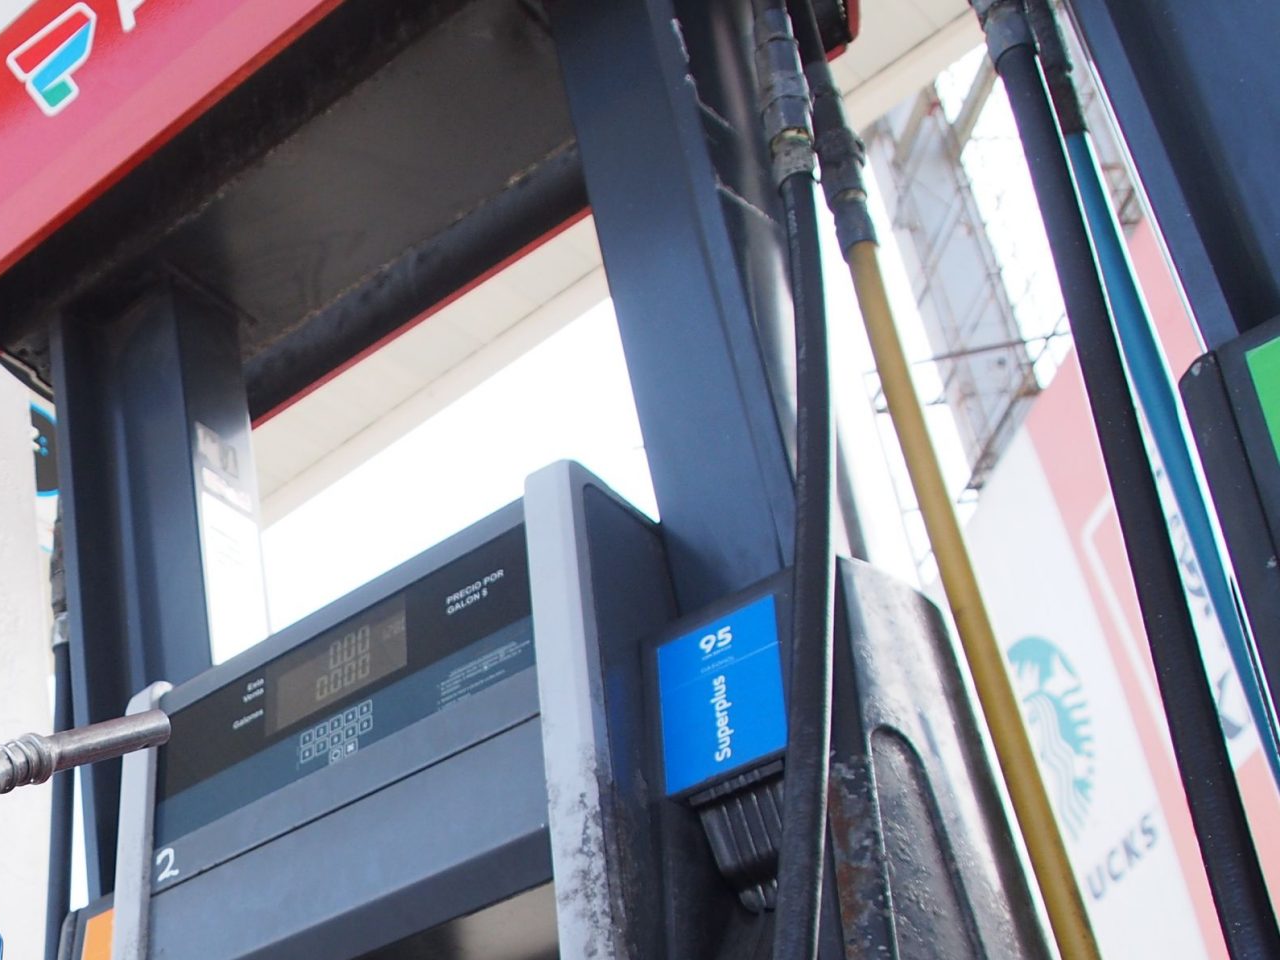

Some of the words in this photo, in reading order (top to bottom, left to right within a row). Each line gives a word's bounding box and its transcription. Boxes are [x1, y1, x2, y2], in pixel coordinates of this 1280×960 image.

[446, 581, 481, 605] PRECIO
[483, 569, 504, 585] POR
[447, 592, 480, 615] GALON
[699, 625, 733, 654] 95
[232, 708, 264, 730] Galones
[710, 674, 734, 762] Superplus
[155, 847, 180, 881] 2
[1086, 814, 1159, 901] UCKS
